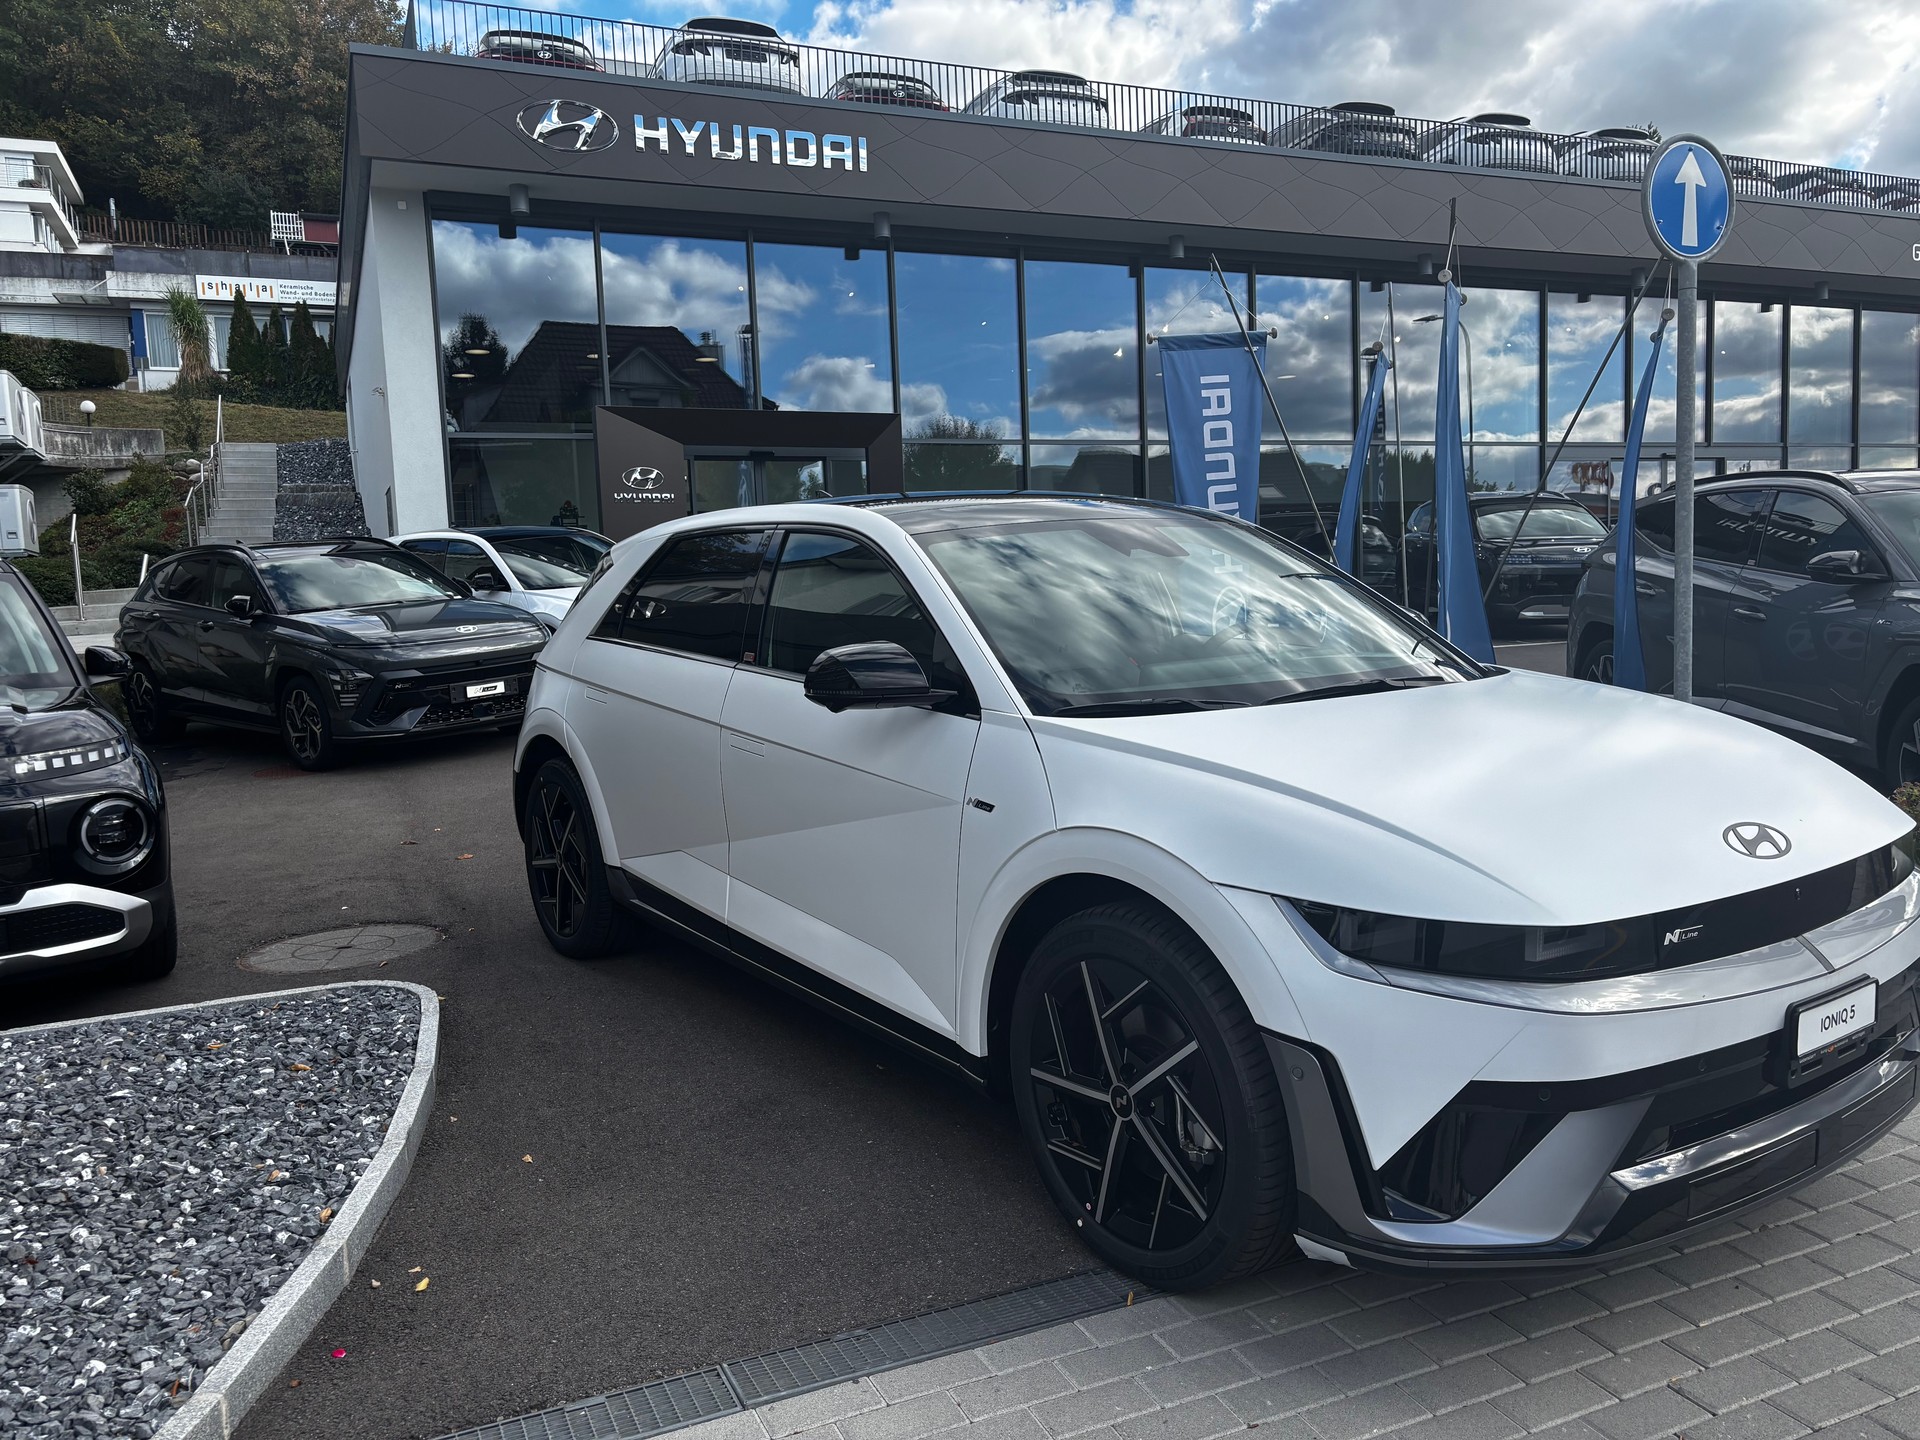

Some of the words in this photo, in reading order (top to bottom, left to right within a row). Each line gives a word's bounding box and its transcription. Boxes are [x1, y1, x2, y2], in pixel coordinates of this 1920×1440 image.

[633, 114, 868, 172] HYUNDAI
[206, 280, 268, 293] shala
[279, 283, 314, 291] Keramische
[1663, 928, 1681, 946] N
[1681, 931, 1699, 940] Line
[1820, 1007, 1849, 1033] IONIQ
[1849, 1004, 1856, 1020] 5
